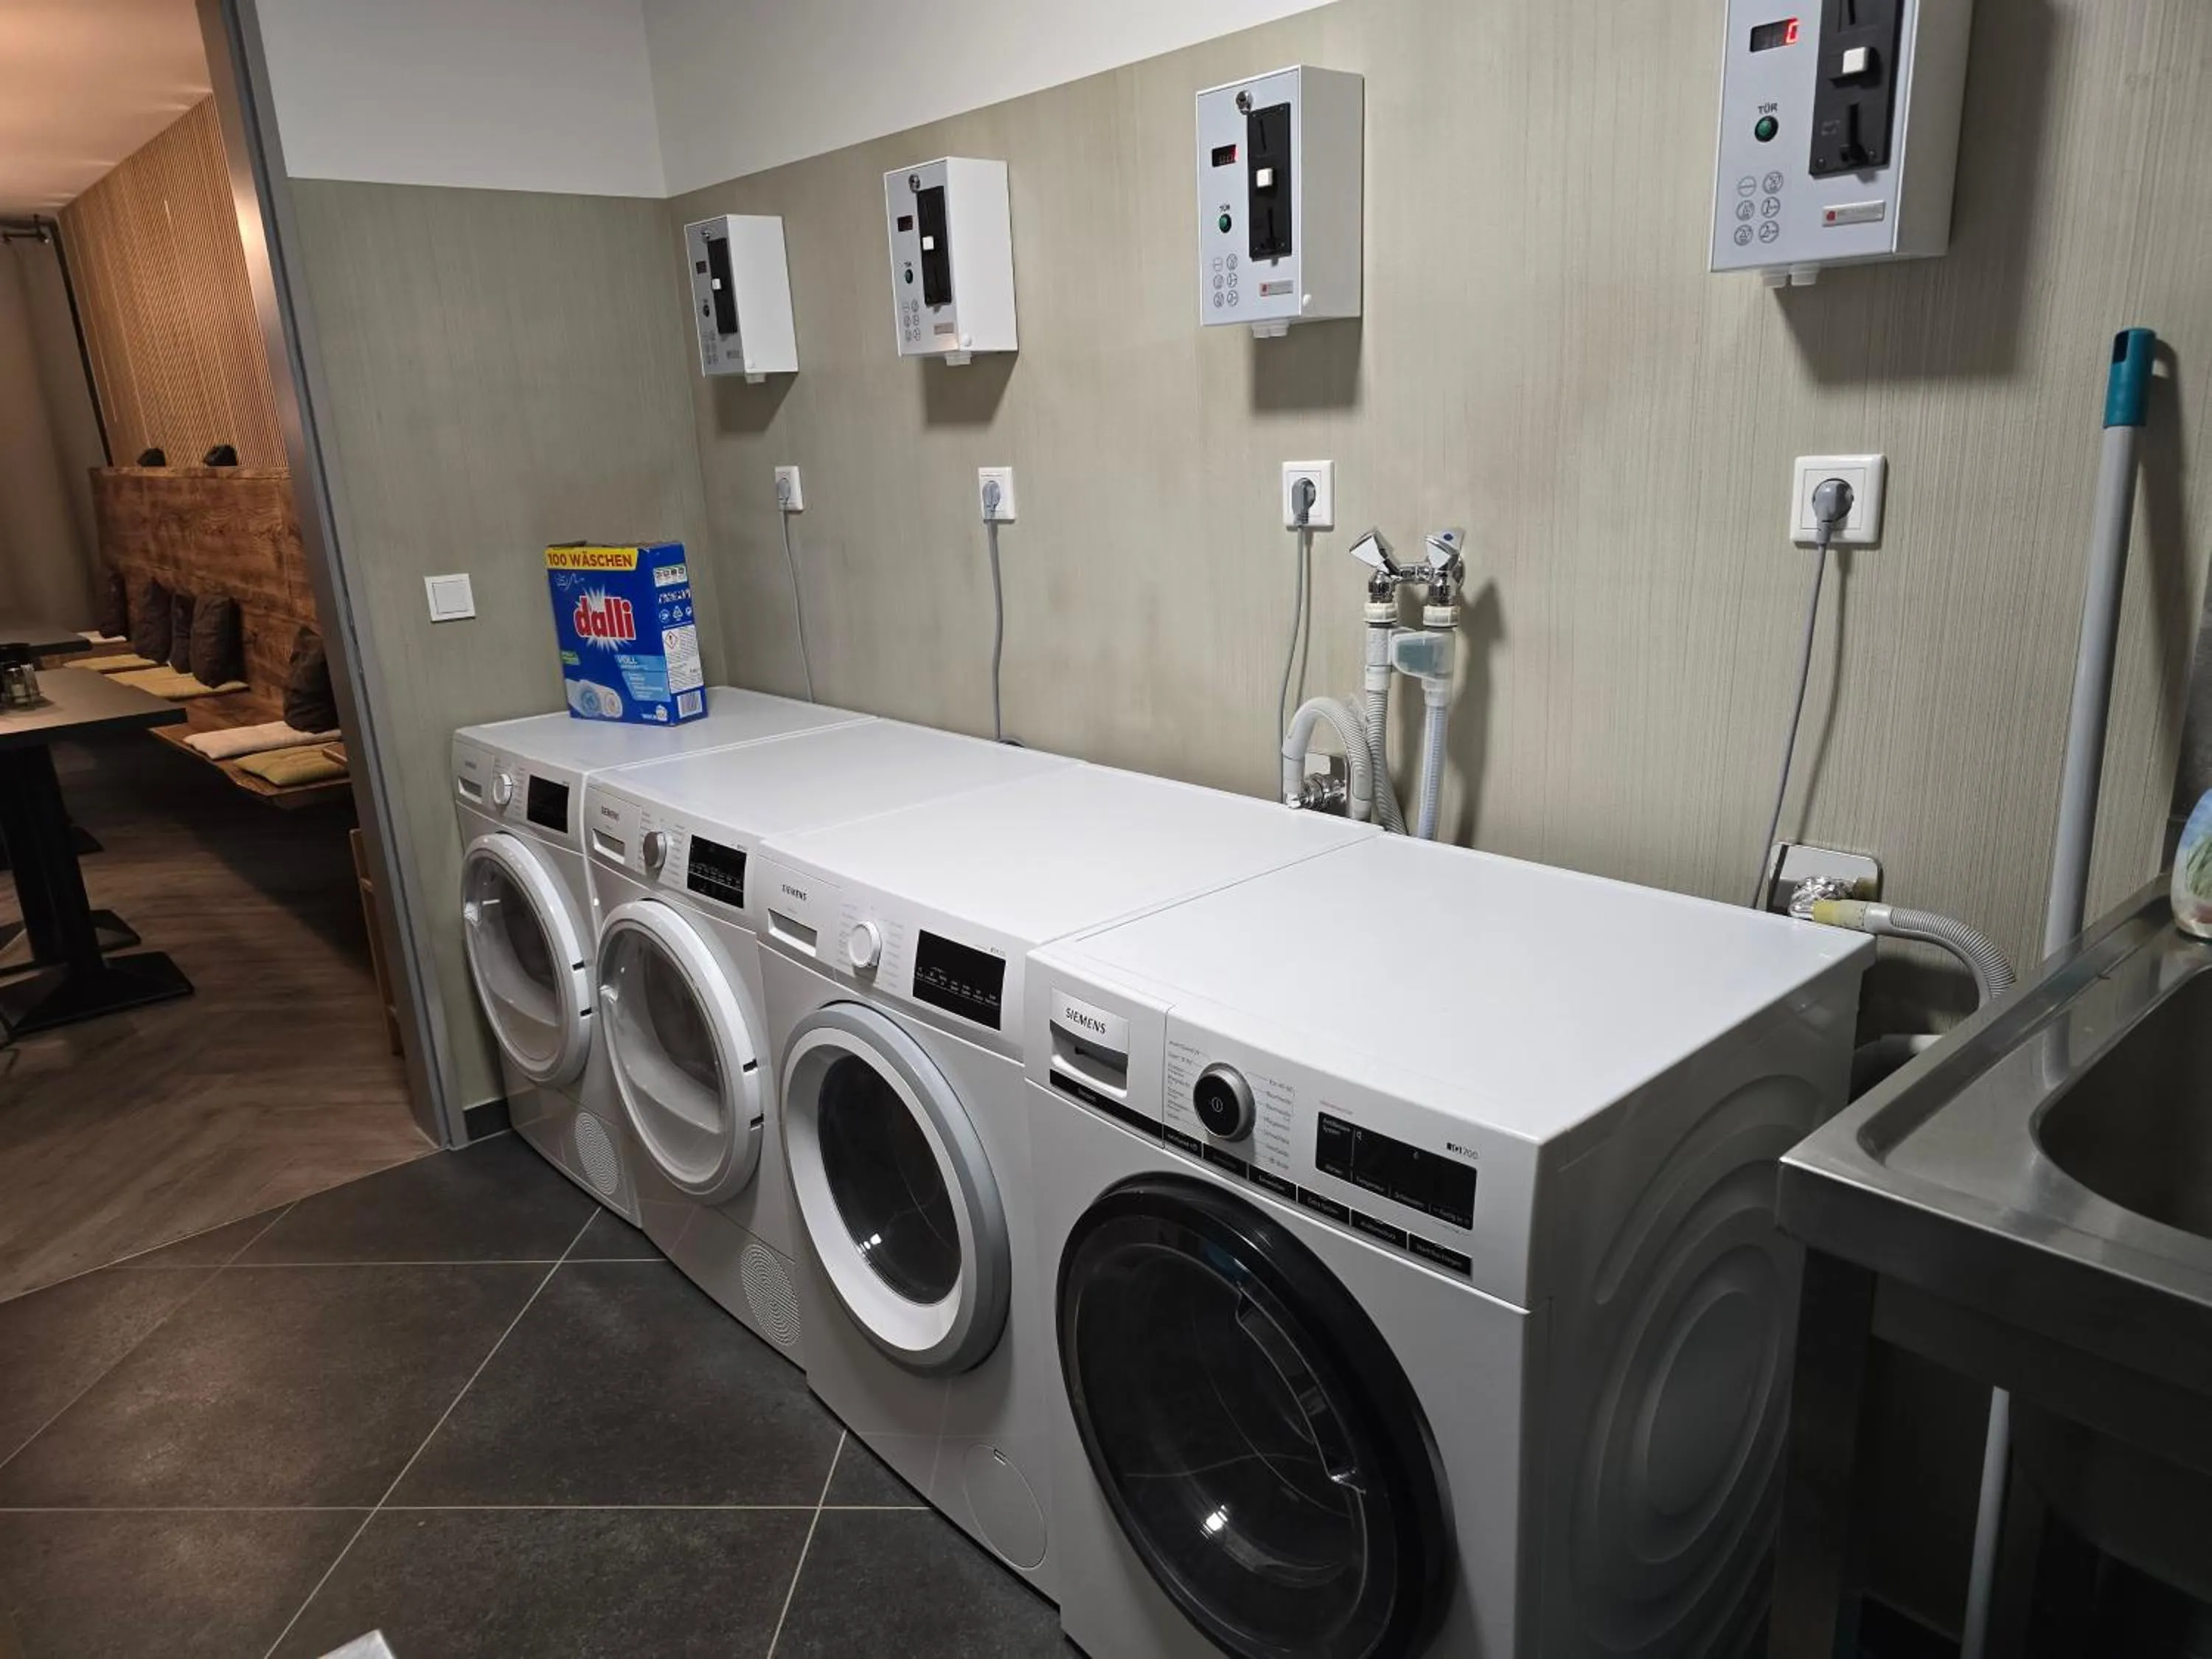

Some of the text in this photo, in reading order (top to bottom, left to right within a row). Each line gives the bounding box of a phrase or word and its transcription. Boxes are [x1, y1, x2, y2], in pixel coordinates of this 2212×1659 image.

[1758, 102, 1778, 114] TÜR
[549, 551, 633, 567] 100 WÄSCHEN
[574, 595, 636, 640] dalli
[780, 884, 807, 901] IEMENS
[1065, 1007, 1107, 1034] SIEMENS
